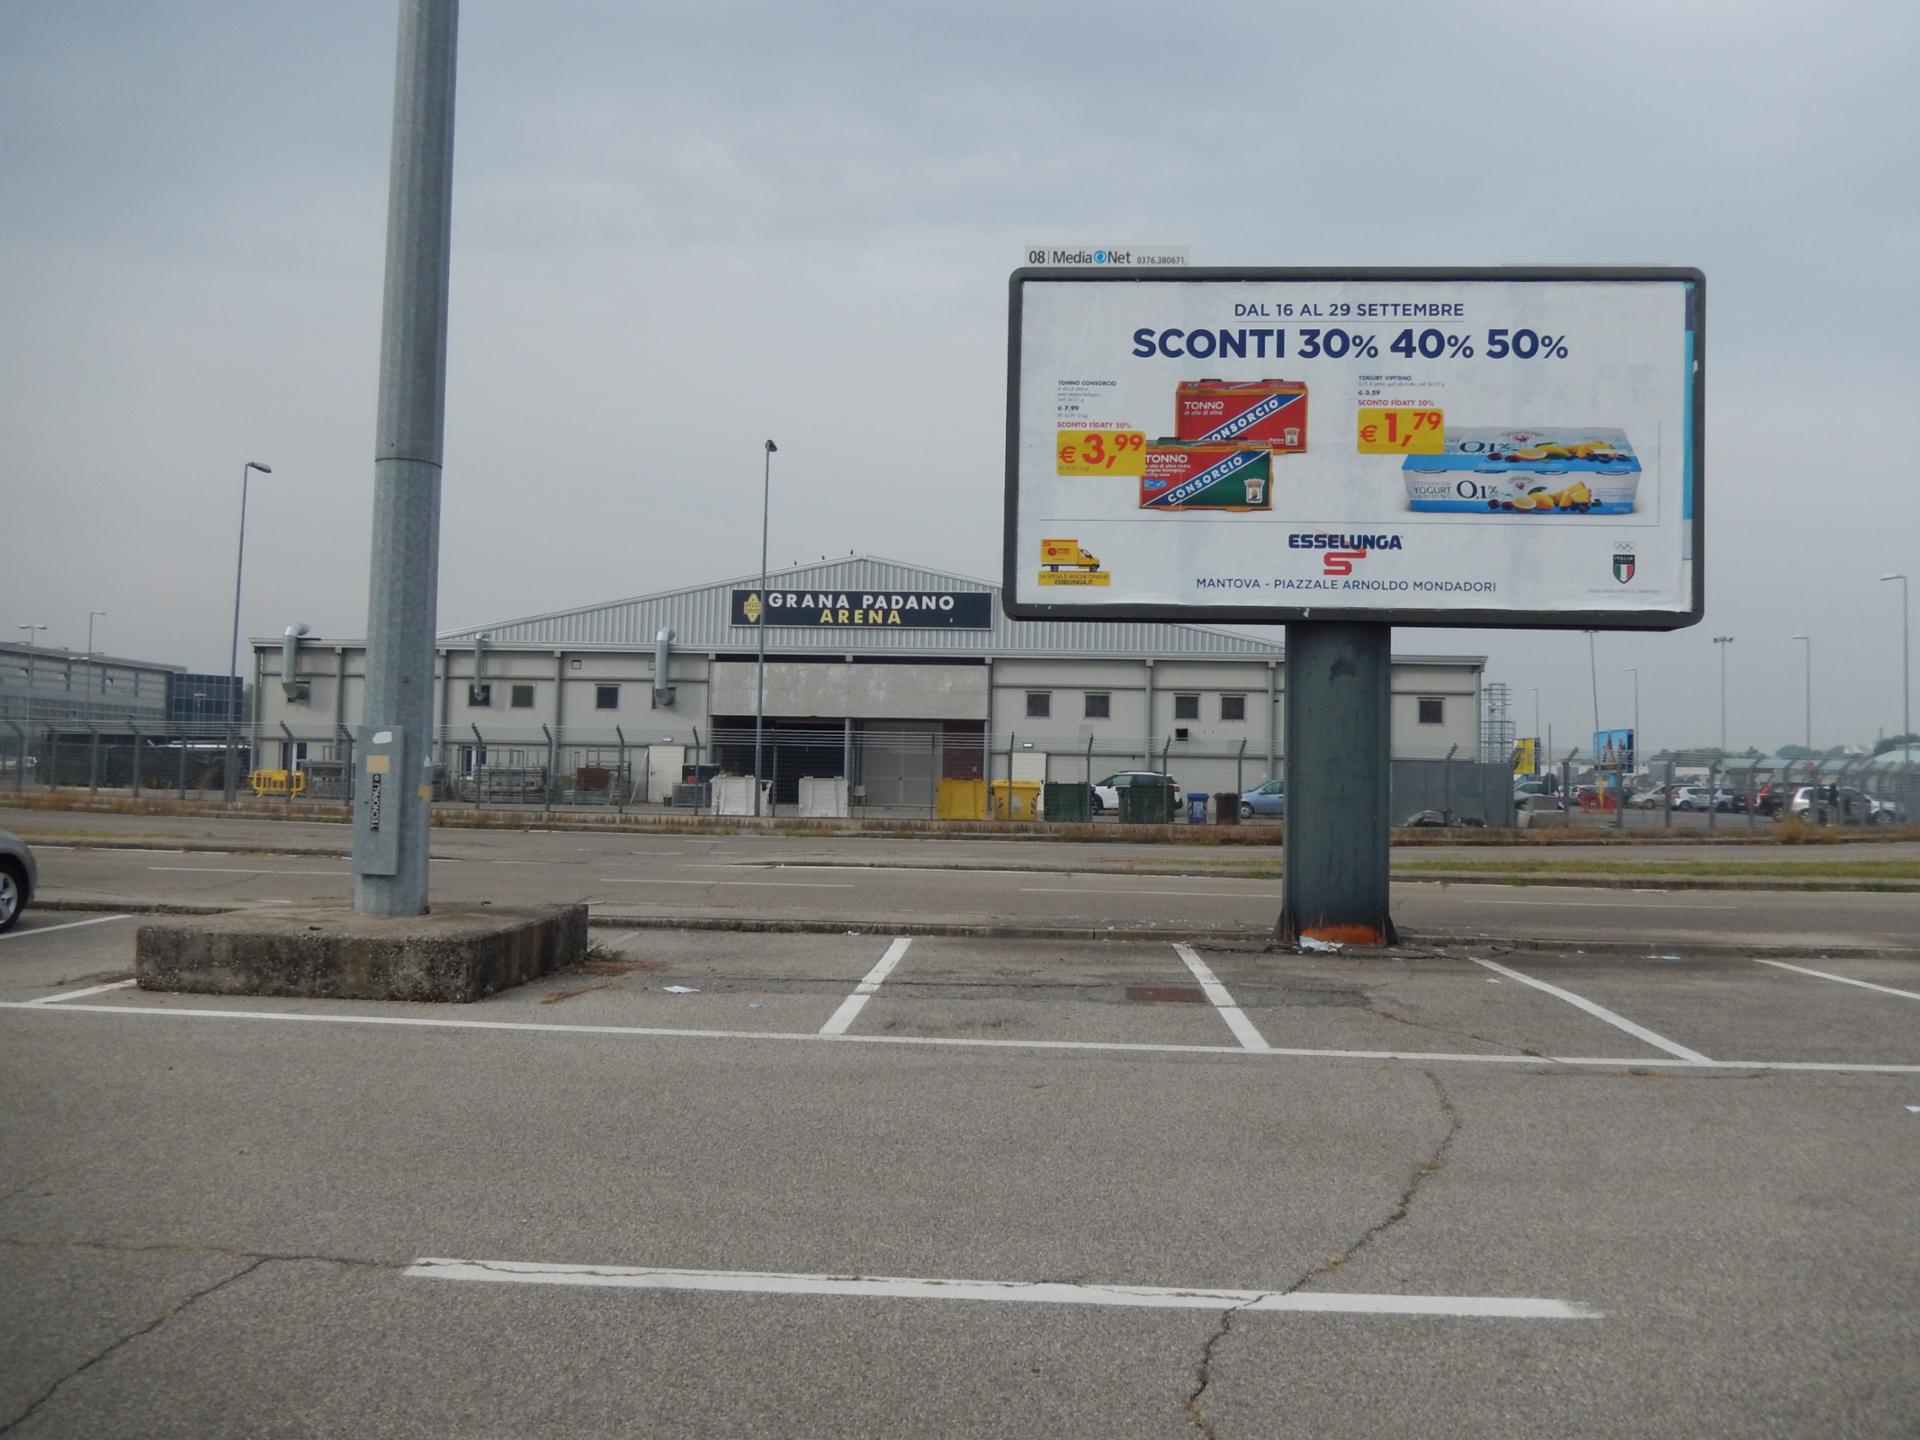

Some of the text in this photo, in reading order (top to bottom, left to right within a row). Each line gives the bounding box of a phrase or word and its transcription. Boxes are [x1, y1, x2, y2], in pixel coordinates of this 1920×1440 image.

[1028, 250, 1046, 264] 08
[1136, 256, 1185, 265] 0376.380671
[1234, 303, 1464, 317] DAL 16 AL 29 SETTEMBRE
[1132, 327, 1569, 360] SCONTI 30% 40% 50%
[1183, 400, 1224, 410] TONNO
[1206, 399, 1279, 441] ONSORCIO
[1359, 411, 1442, 447] € 1,79
[1058, 433, 1144, 469] € 3,99
[1145, 454, 1188, 463] TONNO
[1167, 456, 1243, 503] CONSORCIO
[1413, 486, 1452, 494] YOGURT
[1288, 533, 1403, 550] ESSELUNGA
[1196, 578, 1261, 589] MANTOVA
[1274, 579, 1339, 590] PIAZZALE
[1342, 580, 1409, 591] ARNOLDO
[1413, 581, 1497, 592] MONDADORI
[767, 592, 850, 609] GRANA
[862, 594, 955, 611] PADANO
[819, 609, 902, 624] ARENA
